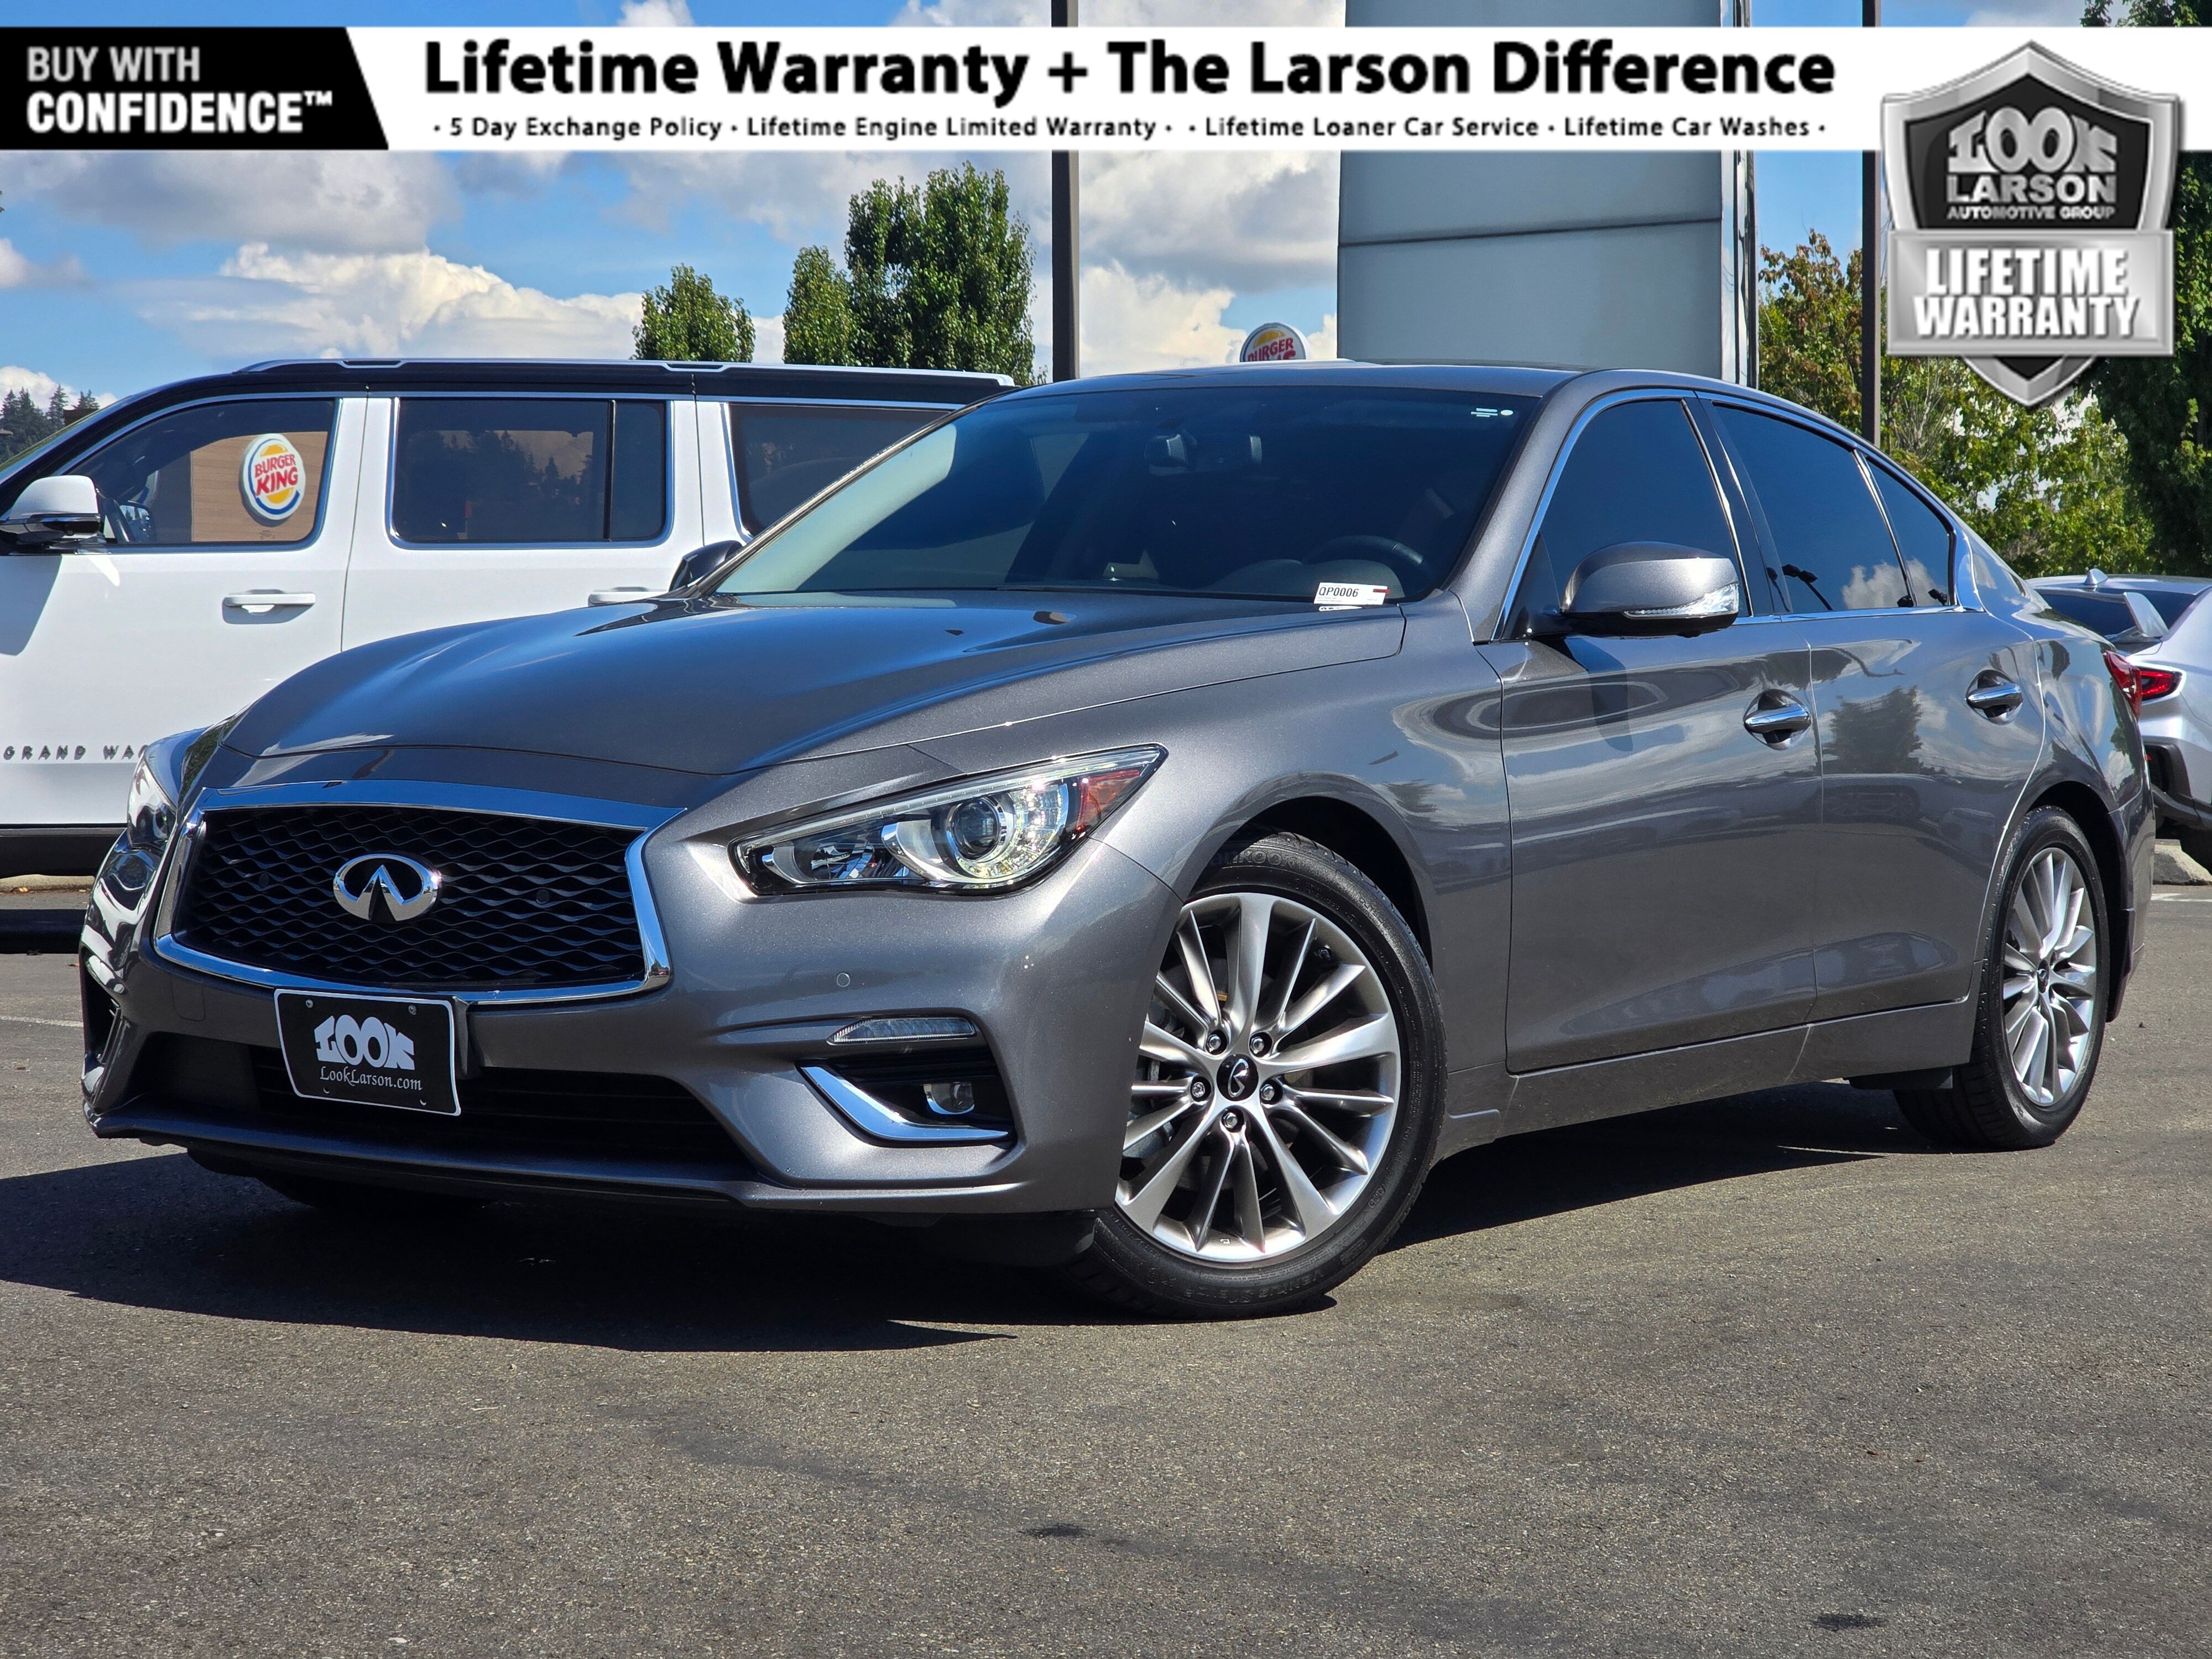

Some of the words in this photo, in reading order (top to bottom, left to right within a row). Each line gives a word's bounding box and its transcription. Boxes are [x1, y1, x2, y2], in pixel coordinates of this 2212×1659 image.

[254, 454, 296, 478] BURGER
[256, 467, 298, 496] KING
[1319, 587, 1359, 597] QP0006
[3, 745, 86, 760] GRAND
[314, 1014, 415, 1070] LOOK
[320, 1066, 423, 1091] LookLarson.com
